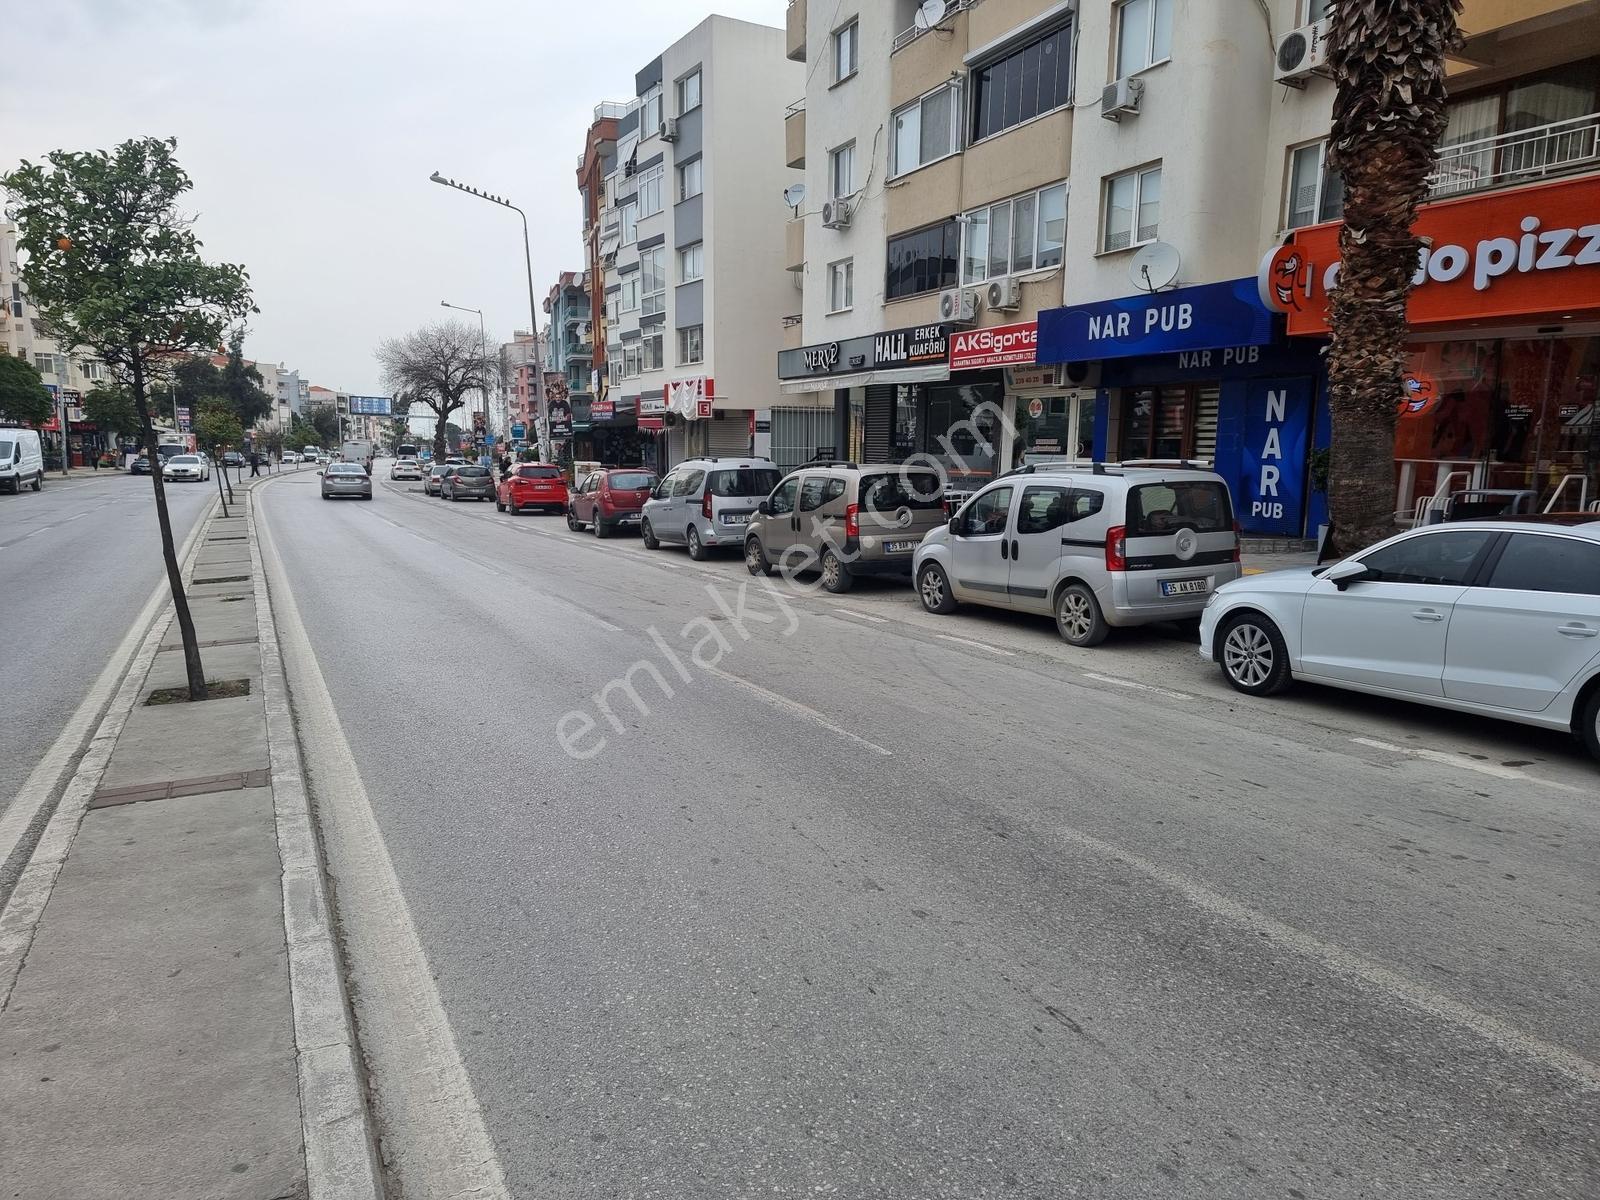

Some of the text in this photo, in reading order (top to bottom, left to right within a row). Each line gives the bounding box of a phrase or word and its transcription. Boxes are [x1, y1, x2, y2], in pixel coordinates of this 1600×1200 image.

[914, 325, 941, 341] ERKEK
[1088, 303, 1193, 341] NAR PUB
[909, 335, 946, 357] KUAFÖRÜ
[954, 330, 1038, 353] AKSigorta
[803, 342, 838, 372] MERVE
[1179, 345, 1260, 369] NAR PUB
[1259, 389, 1287, 497] NAR
[1251, 500, 1283, 519] PUB
[1167, 583, 1177, 593] 35
[1179, 581, 1189, 592] AN
